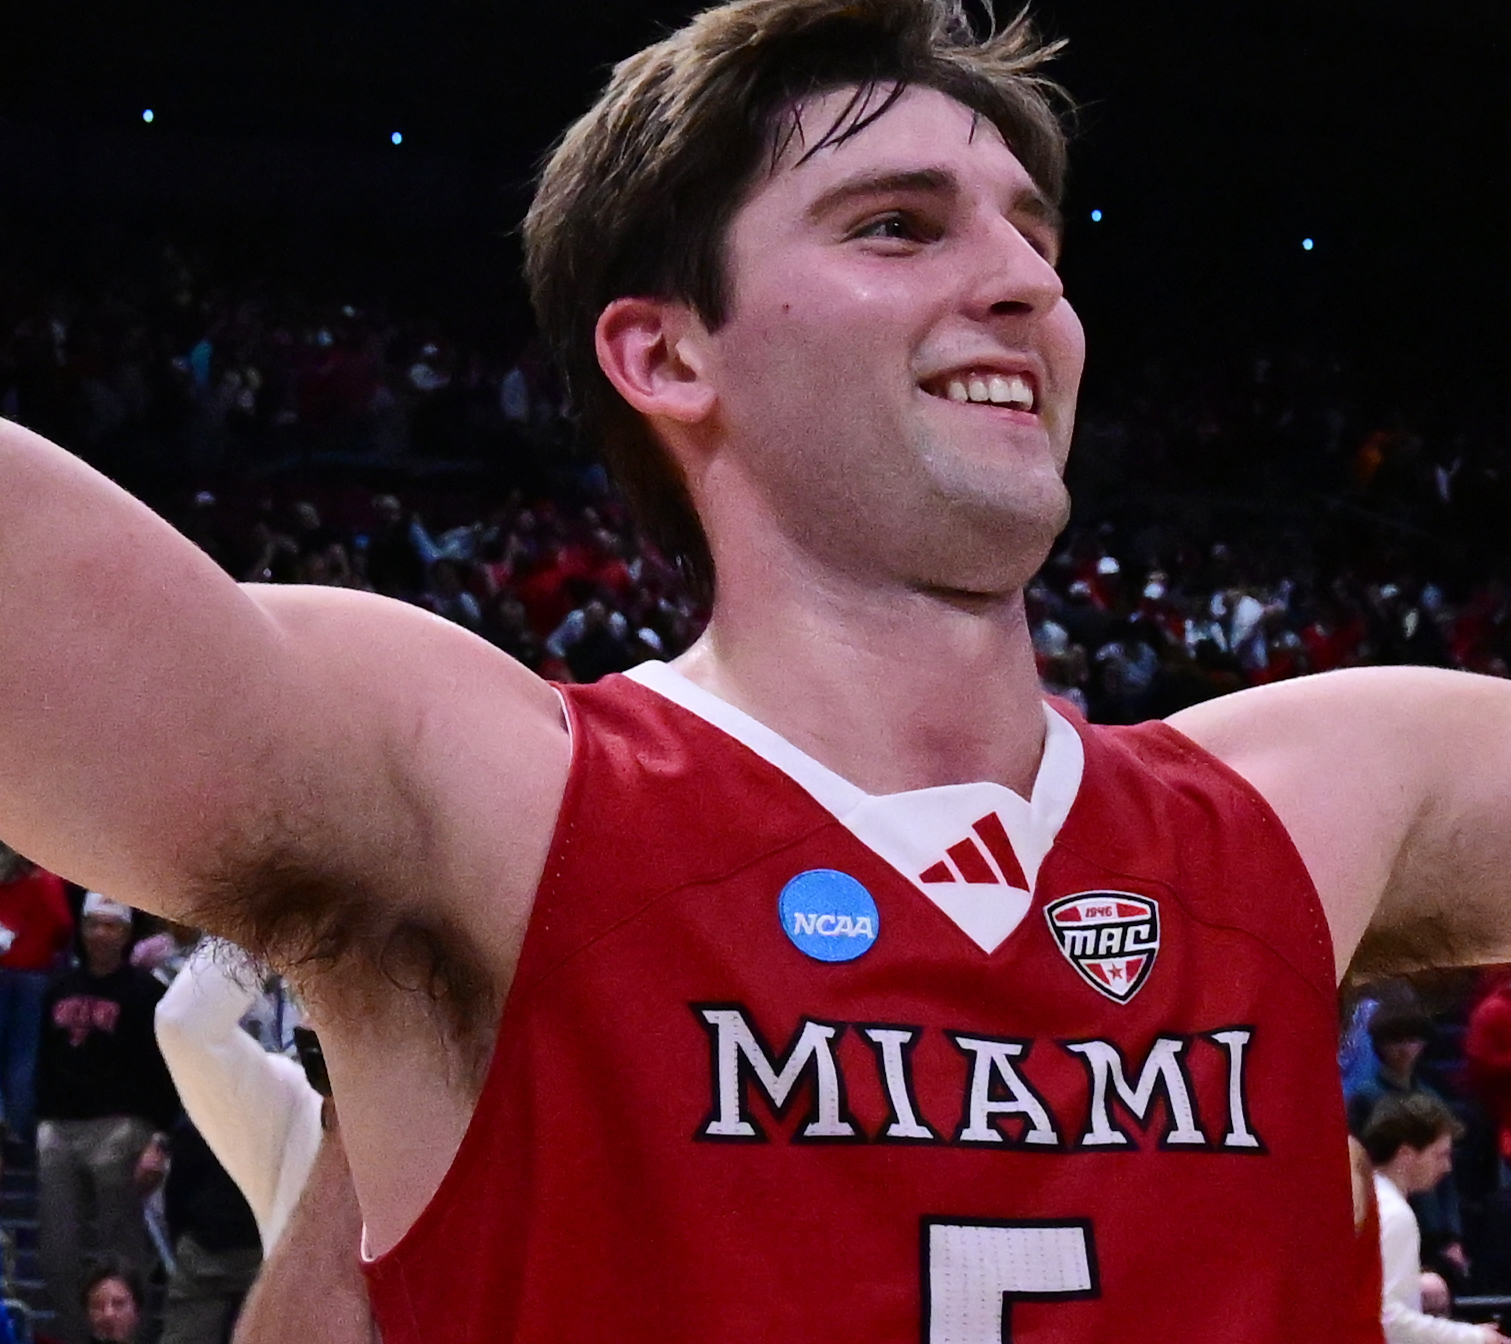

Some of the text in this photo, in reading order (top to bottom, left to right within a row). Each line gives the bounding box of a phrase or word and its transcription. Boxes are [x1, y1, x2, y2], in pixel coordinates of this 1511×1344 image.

[792, 911, 876, 940] NCAA
[1085, 906, 1113, 918] 1946
[1062, 924, 1154, 956] MAC
[691, 1003, 1267, 1153] MIAMI
